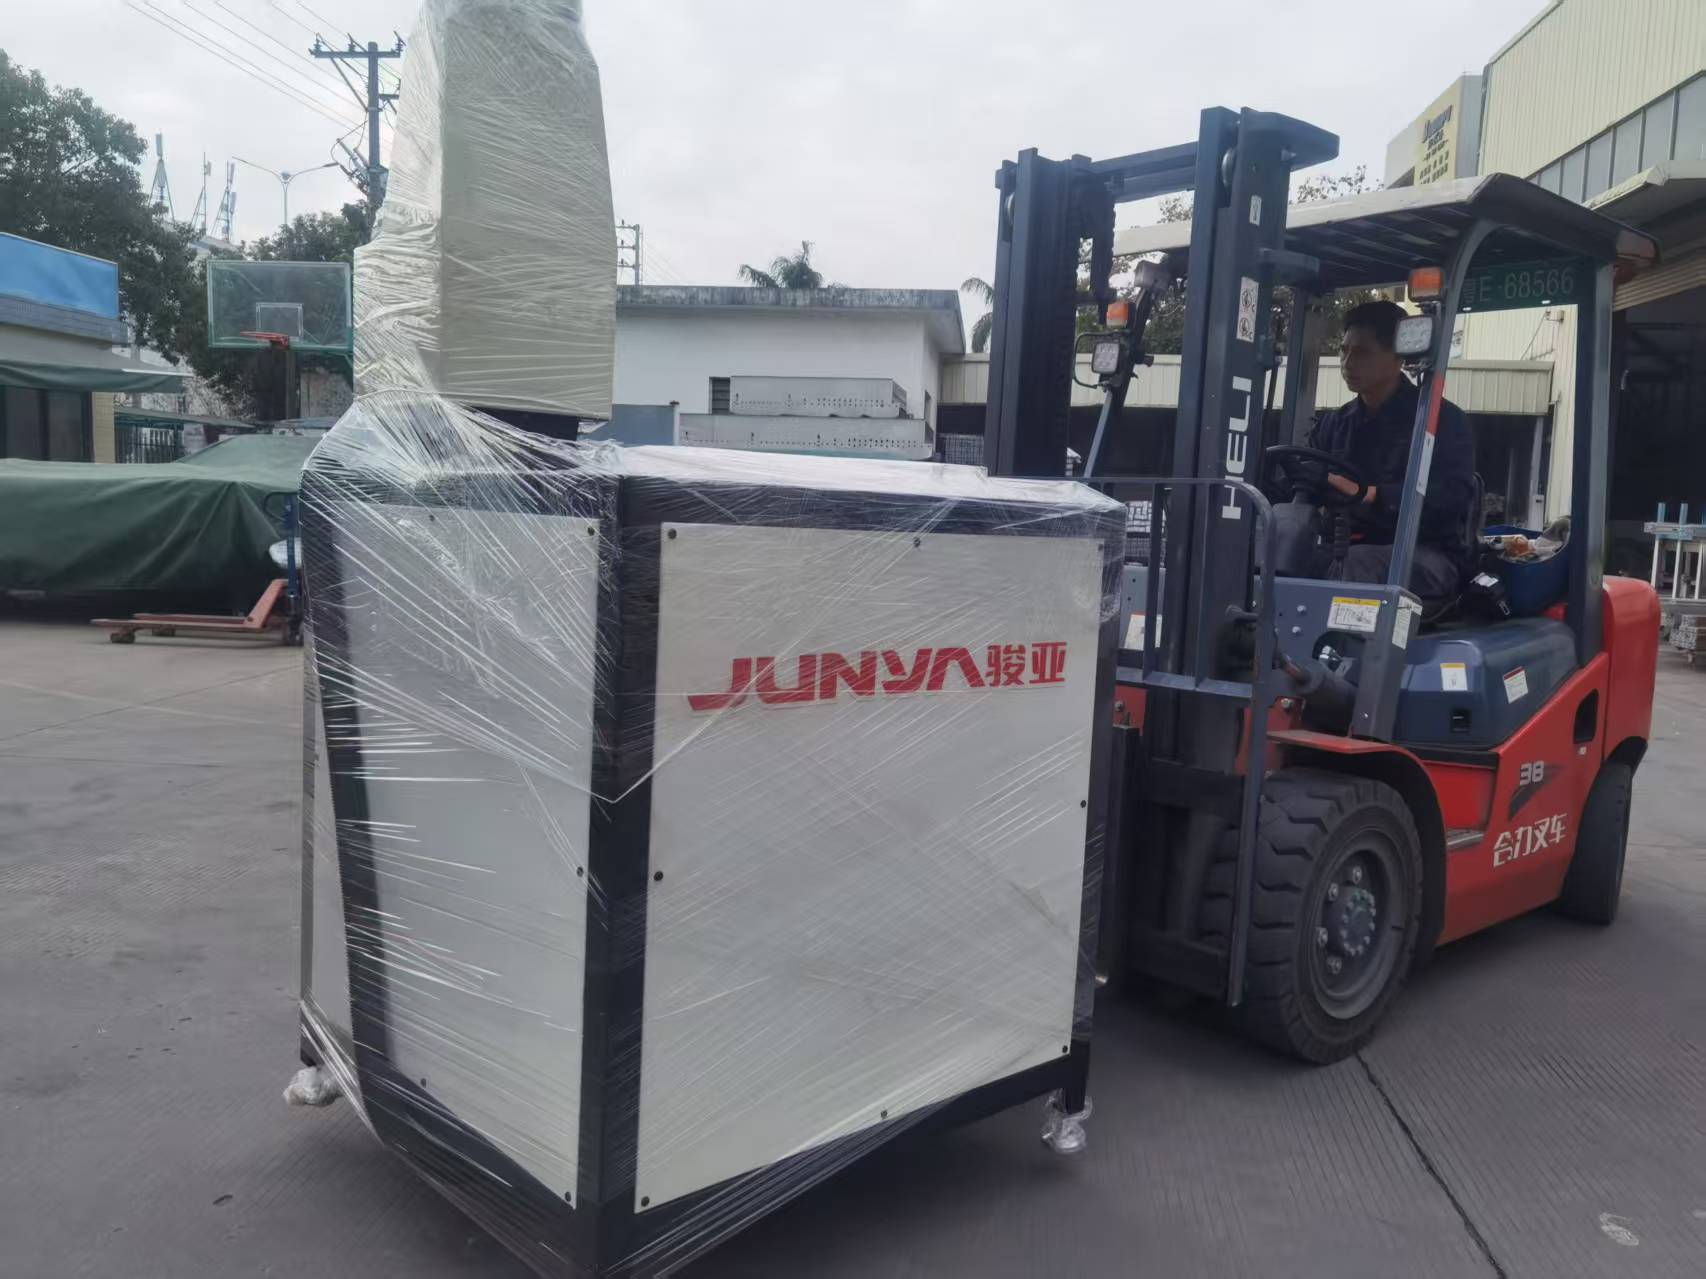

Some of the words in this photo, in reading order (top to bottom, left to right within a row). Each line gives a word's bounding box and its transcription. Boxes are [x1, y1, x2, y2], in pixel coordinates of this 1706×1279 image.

[1221, 376, 1253, 520] HELI
[687, 647, 986, 711] JUNYA
[985, 642, 1068, 687] 骏亚
[1519, 760, 1545, 786] 38
[1493, 812, 1568, 868] 合力叉车
